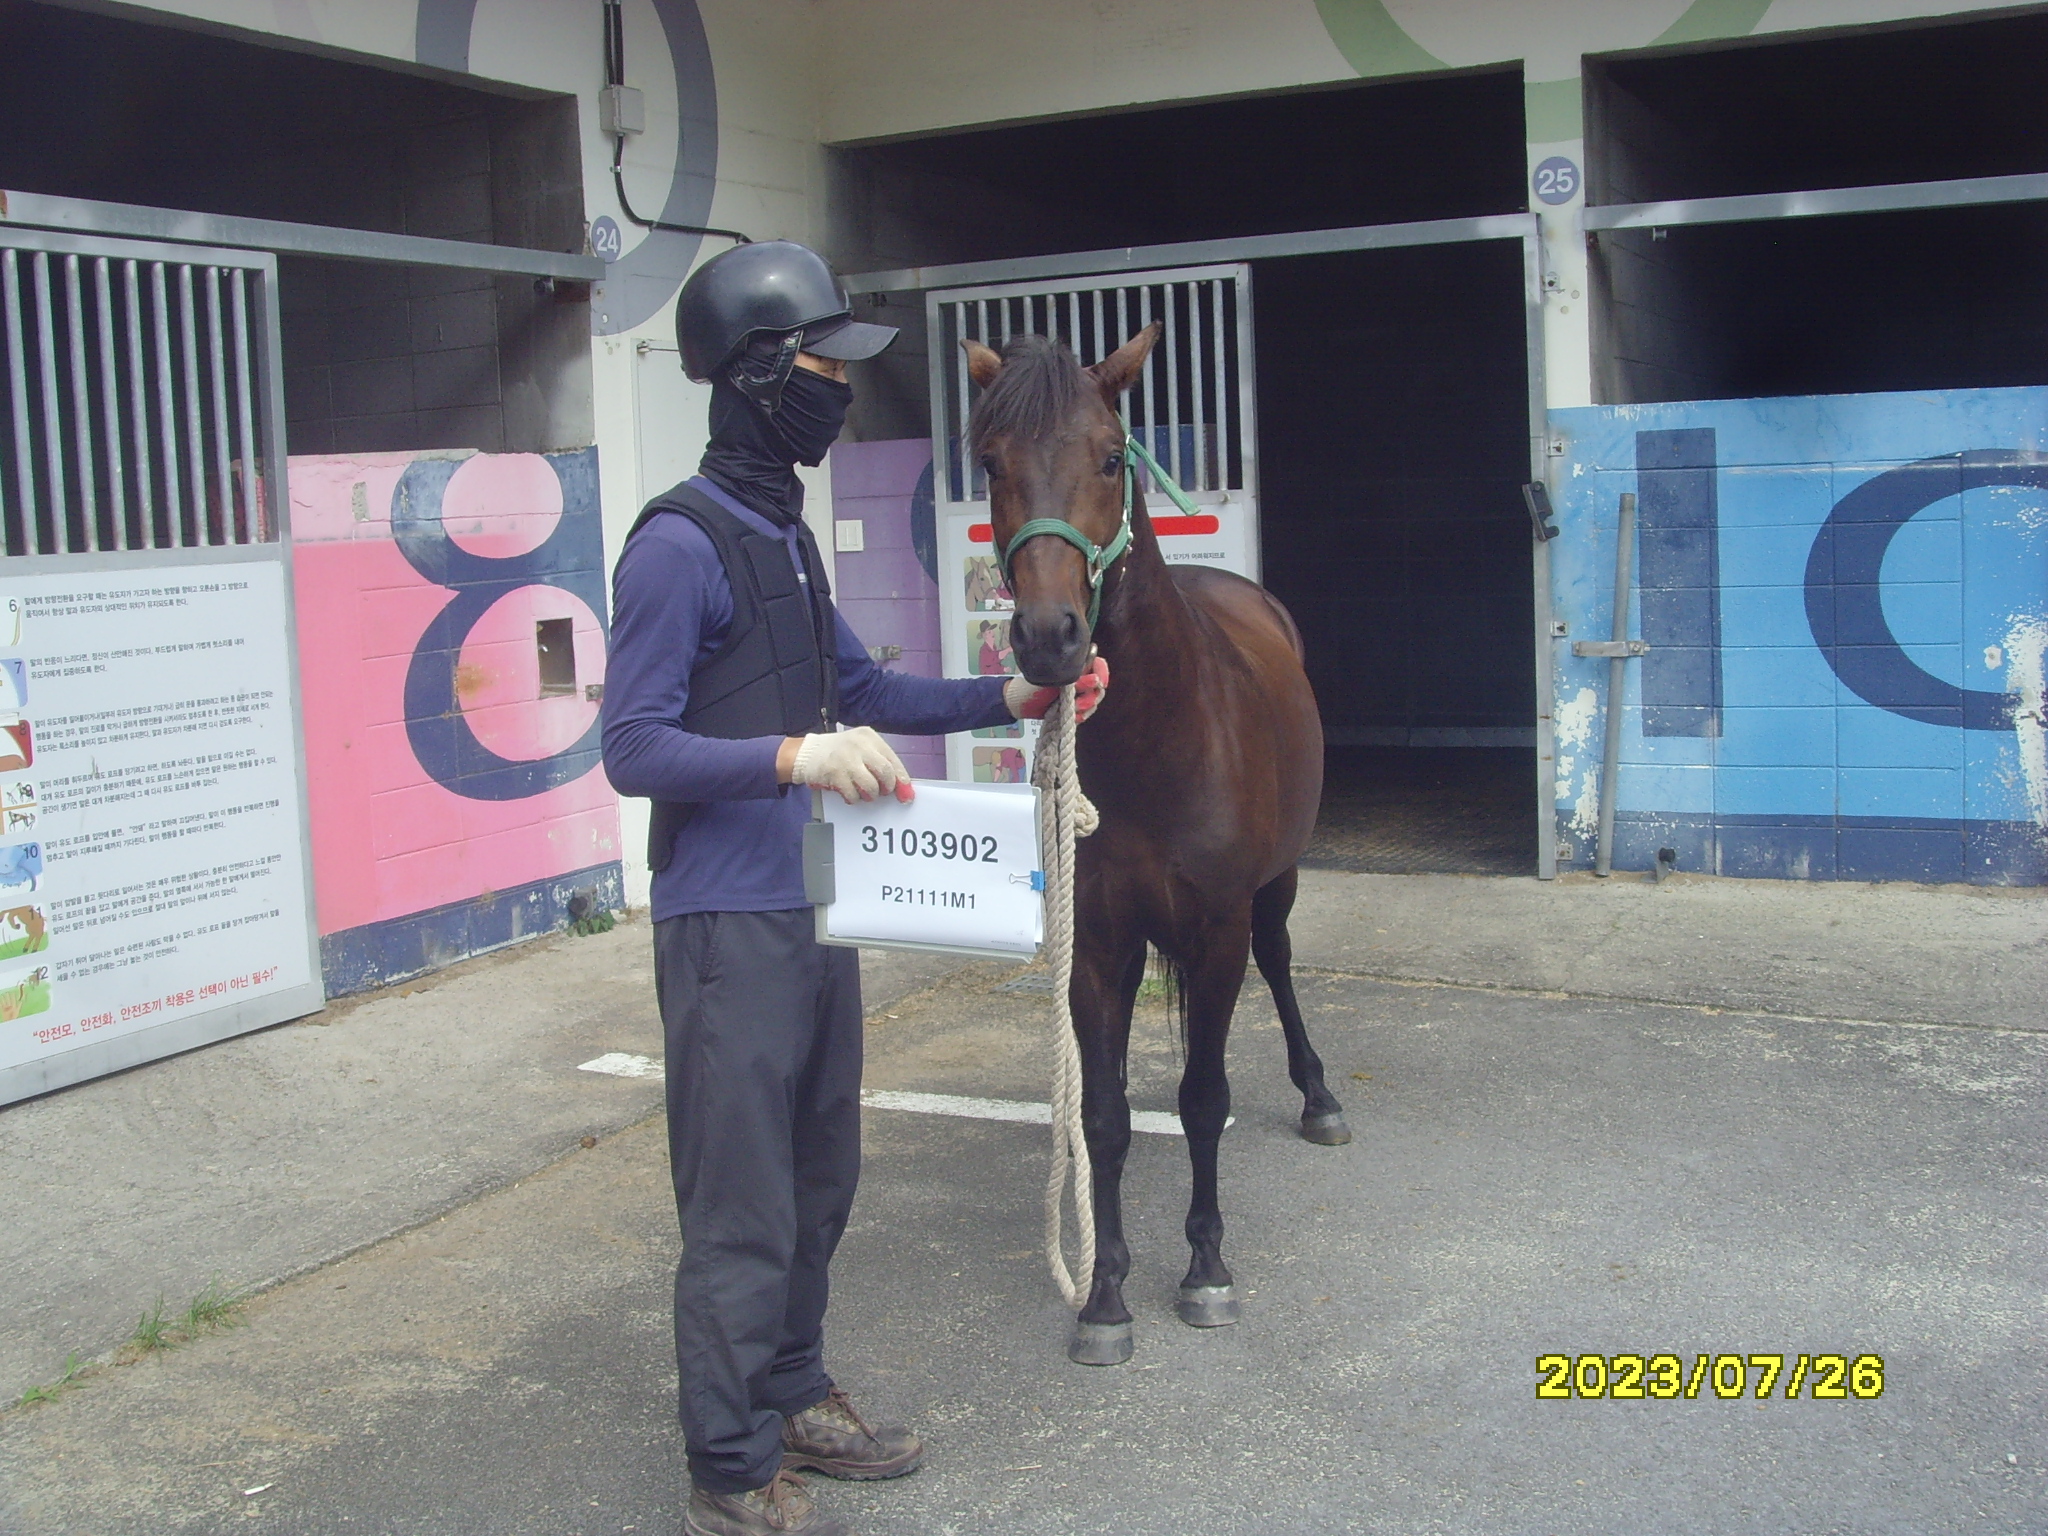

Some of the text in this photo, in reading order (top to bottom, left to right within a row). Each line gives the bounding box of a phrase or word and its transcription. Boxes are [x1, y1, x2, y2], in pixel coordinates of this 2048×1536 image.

[1538, 168, 1574, 194] 25
[596, 227, 618, 253] 24
[9, 599, 18, 612] 6
[14, 662, 22, 674] 7
[23, 845, 38, 859] 10
[862, 826, 998, 863] 3103902
[882, 885, 976, 909] P21111M1
[29, 906, 42, 920] 11
[34, 966, 49, 980] 12
[33, 966, 278, 1044] “안전모, 안전화, 안전조끼 착용은 선택이 아닌 필수!”
